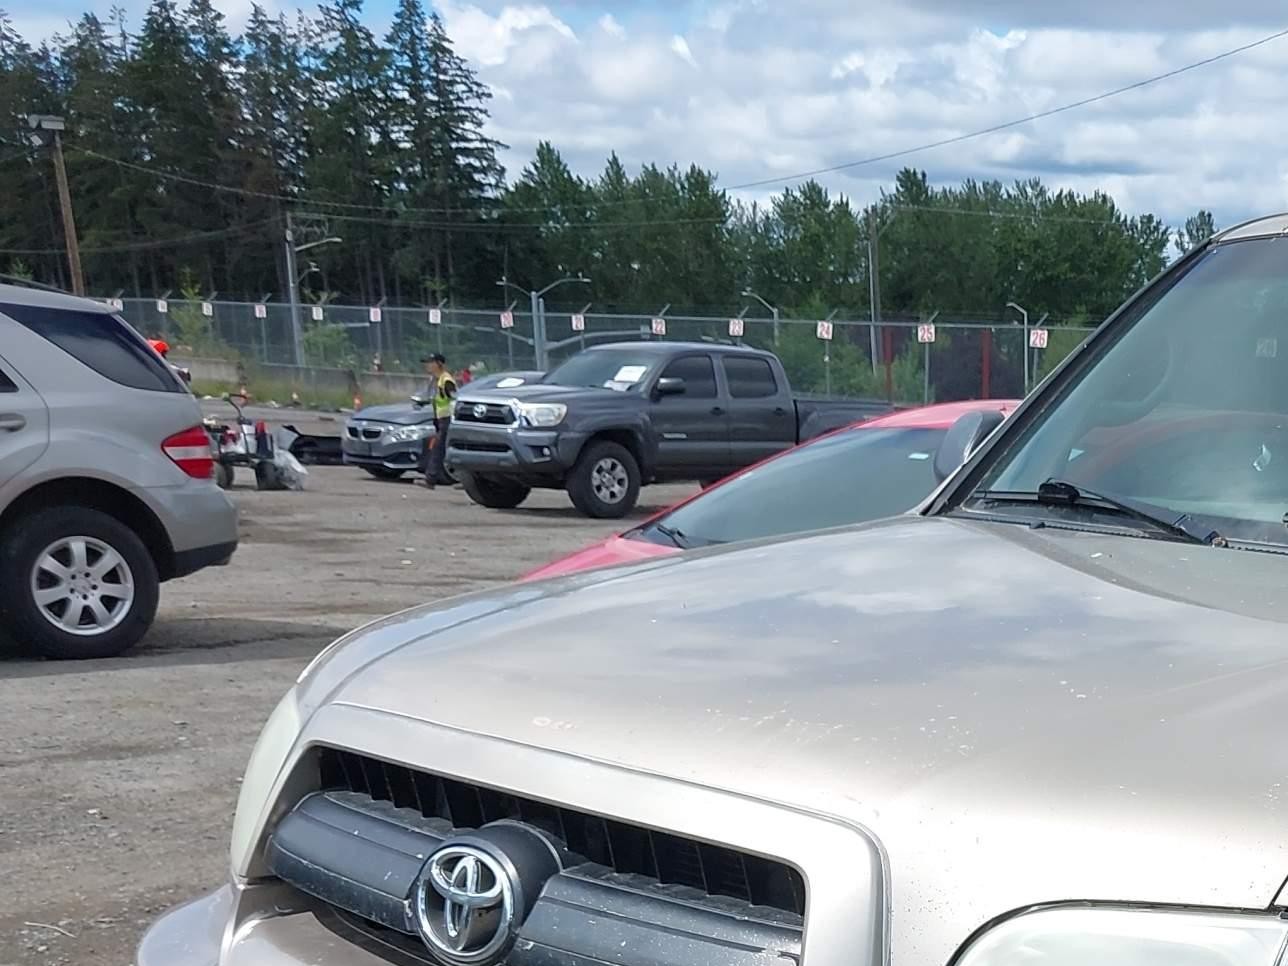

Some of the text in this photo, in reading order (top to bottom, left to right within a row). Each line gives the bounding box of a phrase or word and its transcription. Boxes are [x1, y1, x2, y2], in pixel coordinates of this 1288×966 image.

[819, 322, 831, 337] 24
[920, 325, 933, 341] 25
[1032, 331, 1046, 346] 26
